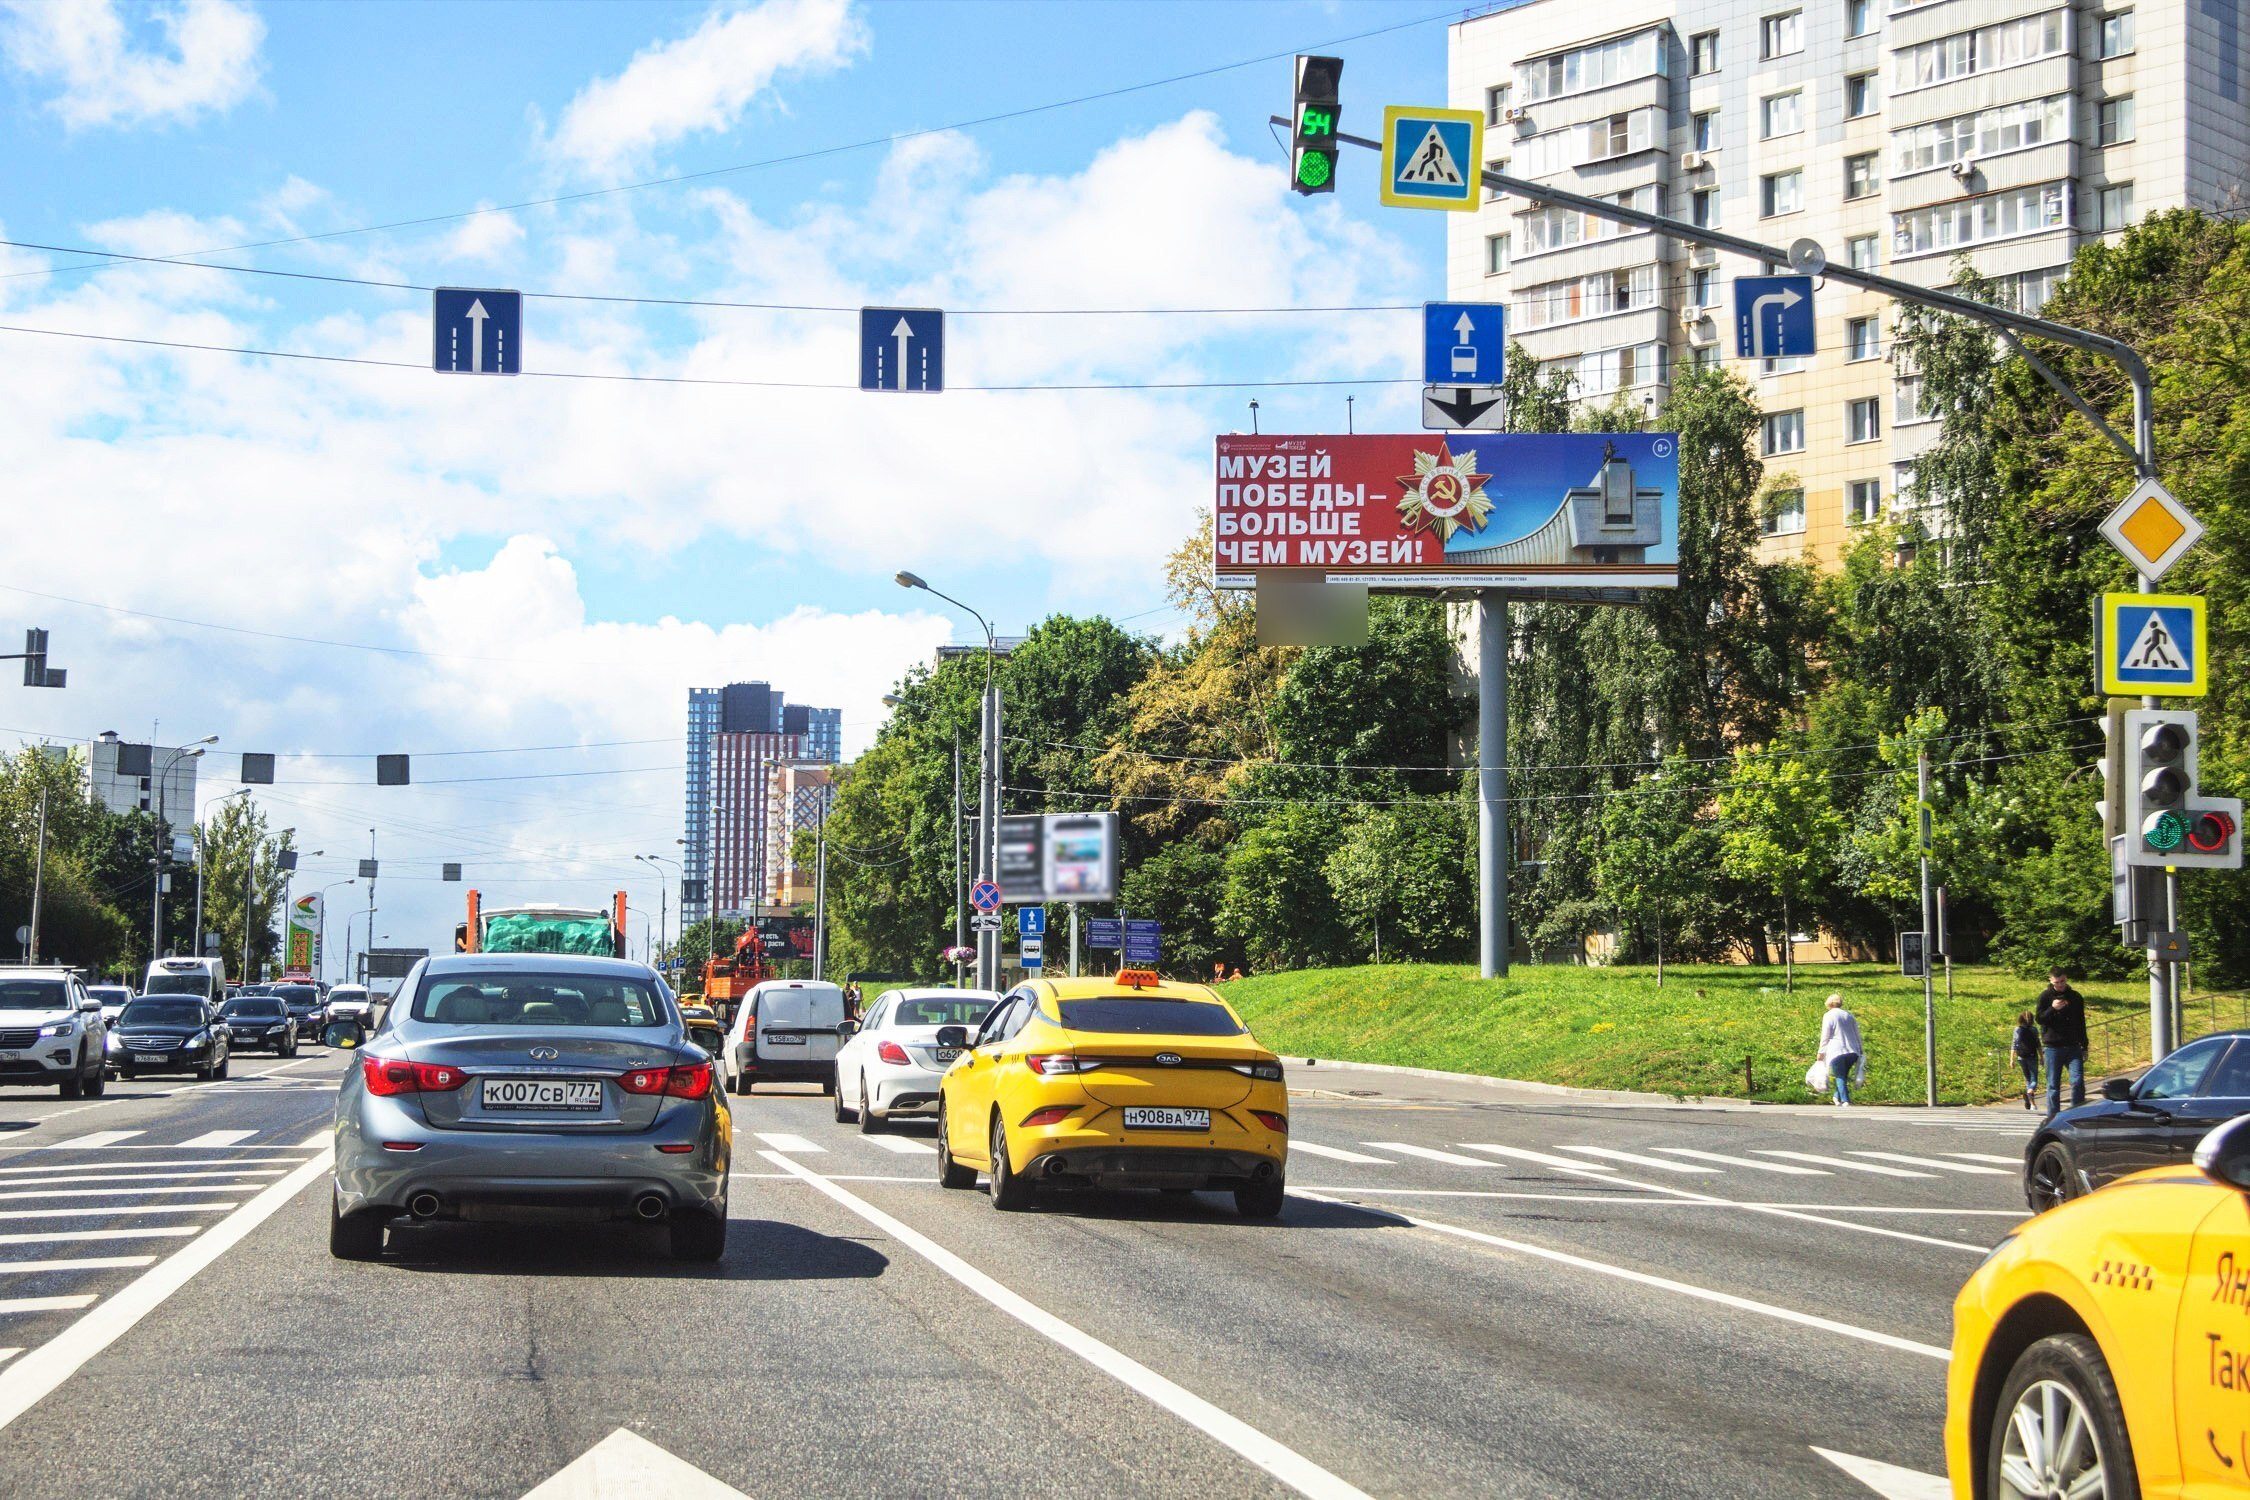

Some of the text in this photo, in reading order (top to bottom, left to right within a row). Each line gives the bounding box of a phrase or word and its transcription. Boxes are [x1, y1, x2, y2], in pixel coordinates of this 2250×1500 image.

[1303, 111, 1331, 136] 54
[1219, 449, 1331, 479] МУЗЕЙ
[1219, 512, 1361, 536] БОЛЬШЕ
[1219, 534, 1423, 564] ЧЕМ МУЗЕЙ!
[490, 1083, 596, 1102] К007СВ 777
[1129, 1110, 1206, 1124] Н908ВА 977
